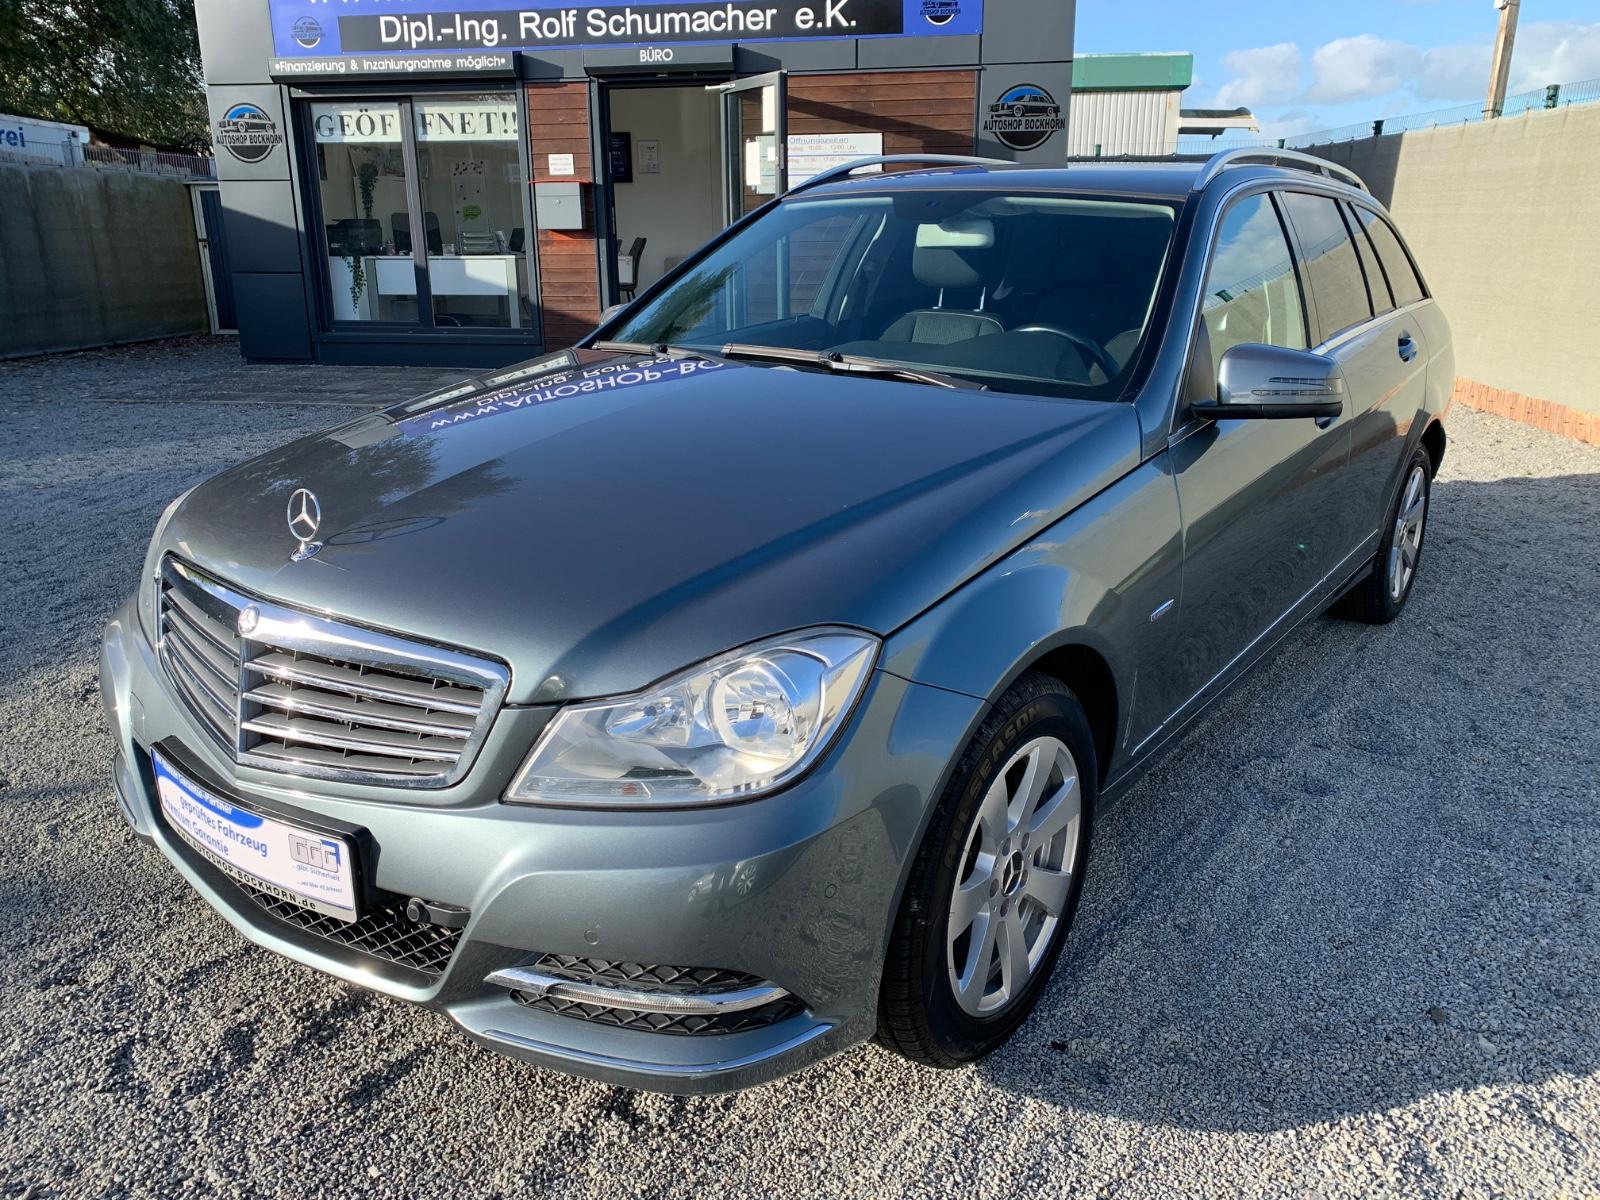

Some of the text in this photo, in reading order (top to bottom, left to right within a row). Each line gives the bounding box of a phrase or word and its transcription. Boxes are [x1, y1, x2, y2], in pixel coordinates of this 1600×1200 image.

[379, 0, 858, 48] Dipl.-Ing. Rolf Schumacher e.K.
[639, 47, 674, 63] BÜRO
[350, 60, 360, 71] &
[363, 57, 452, 72] Inzahlungnahme
[983, 117, 1066, 131] AUTOSHOP BOCKHORN
[216, 133, 283, 145] AUTOSHOP BOCKHORN
[788, 136, 849, 145] Öffnungszeiten
[179, 796, 269, 858] geprüftes Fahrzeug
[191, 821, 230, 856] Garantie
[309, 867, 342, 882] Sicherheit
